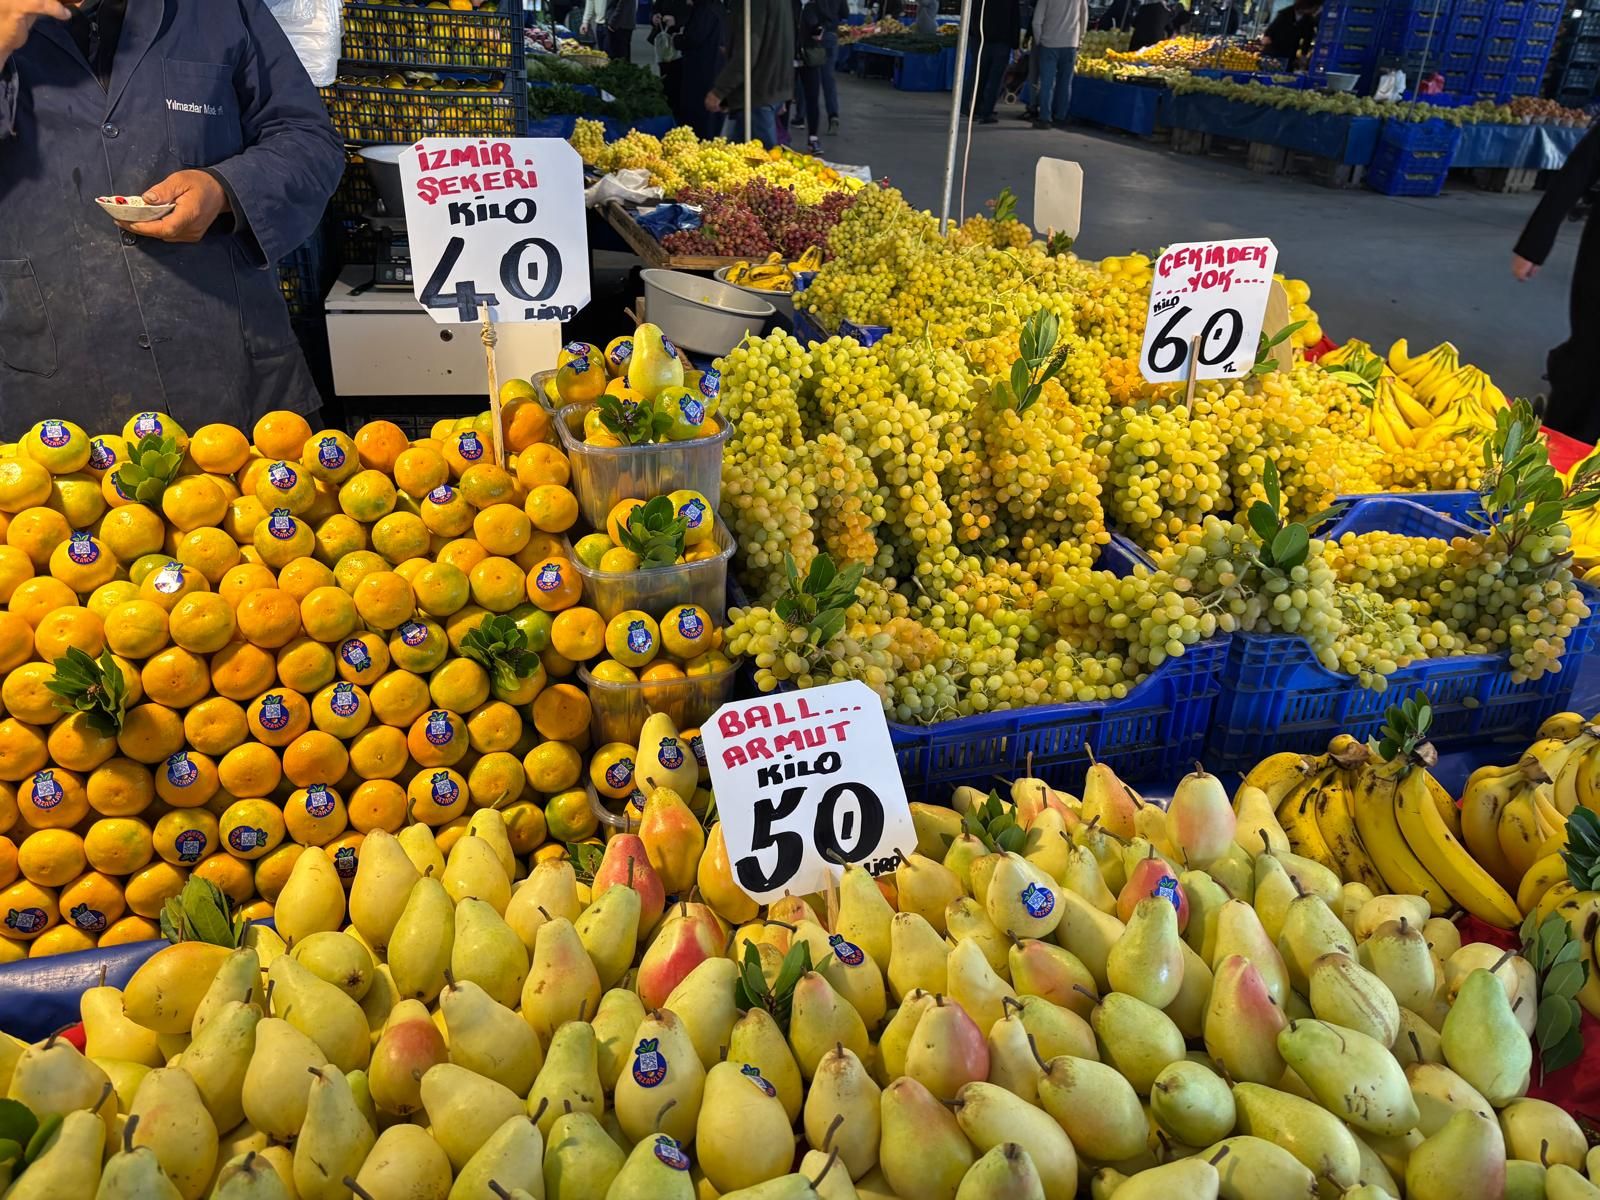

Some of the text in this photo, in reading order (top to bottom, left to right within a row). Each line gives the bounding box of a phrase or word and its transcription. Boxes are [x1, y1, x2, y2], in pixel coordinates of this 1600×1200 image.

[415, 140, 514, 172] İZMİR
[416, 159, 538, 205] ŞEKERİ
[448, 195, 537, 226] KİLO
[419, 236, 563, 322] 40
[1159, 244, 1269, 279] ÇEKİRDEK
[1147, 305, 1244, 373] 60
[1222, 361, 1237, 373] TL
[722, 720, 851, 770] ARMUT
[757, 751, 842, 788] KİLO
[735, 781, 885, 893] 50
[634, 1067, 666, 1085] KAZANLAR
